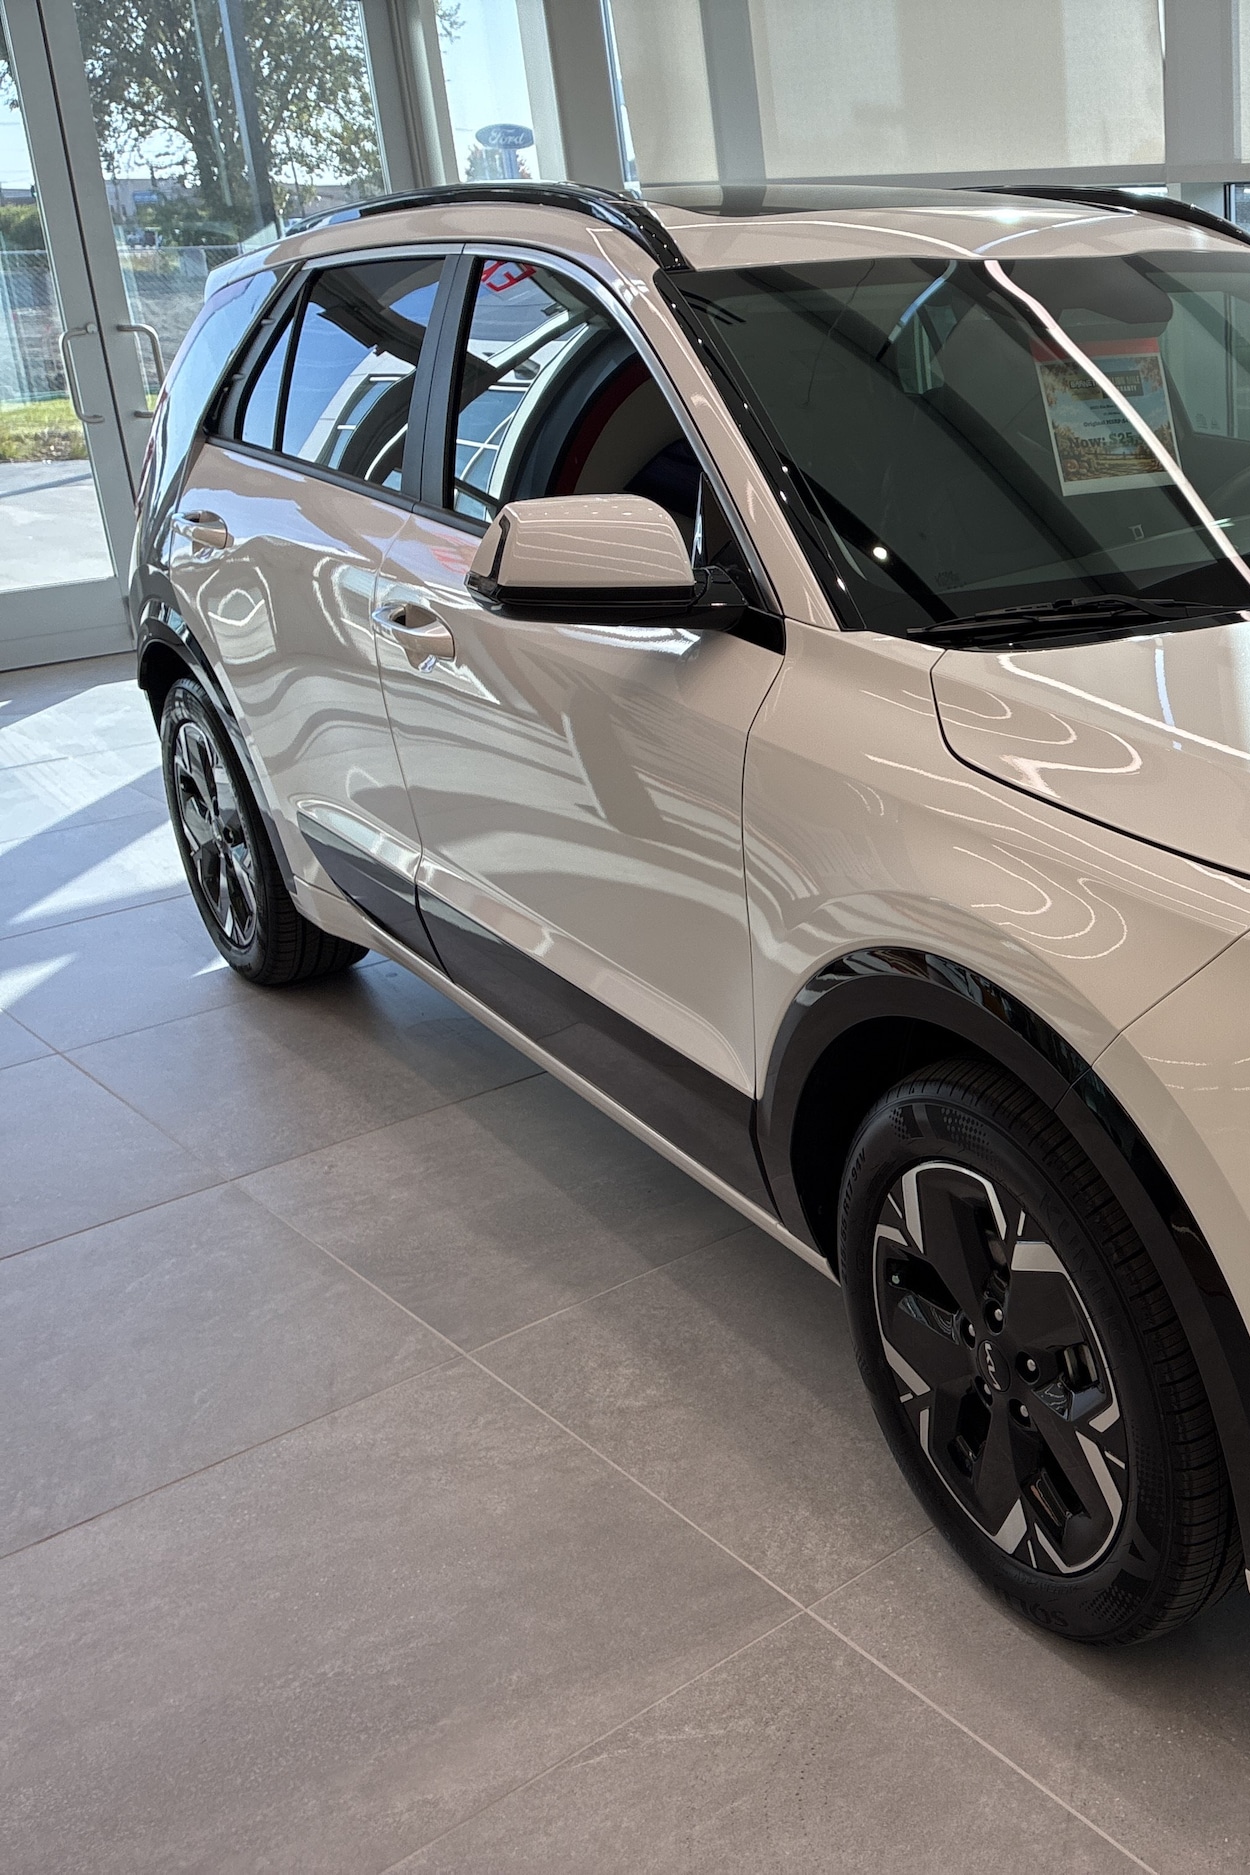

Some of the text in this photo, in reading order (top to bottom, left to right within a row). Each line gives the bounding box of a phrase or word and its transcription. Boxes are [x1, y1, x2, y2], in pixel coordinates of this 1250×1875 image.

[488, 128, 525, 146] Ford
[1070, 379, 1098, 389] BARNET
[1109, 432, 1143, 447] $25,
[842, 1178, 853, 1214] R17
[851, 1148, 867, 1183] 94V
[984, 1342, 1003, 1391] KIA
